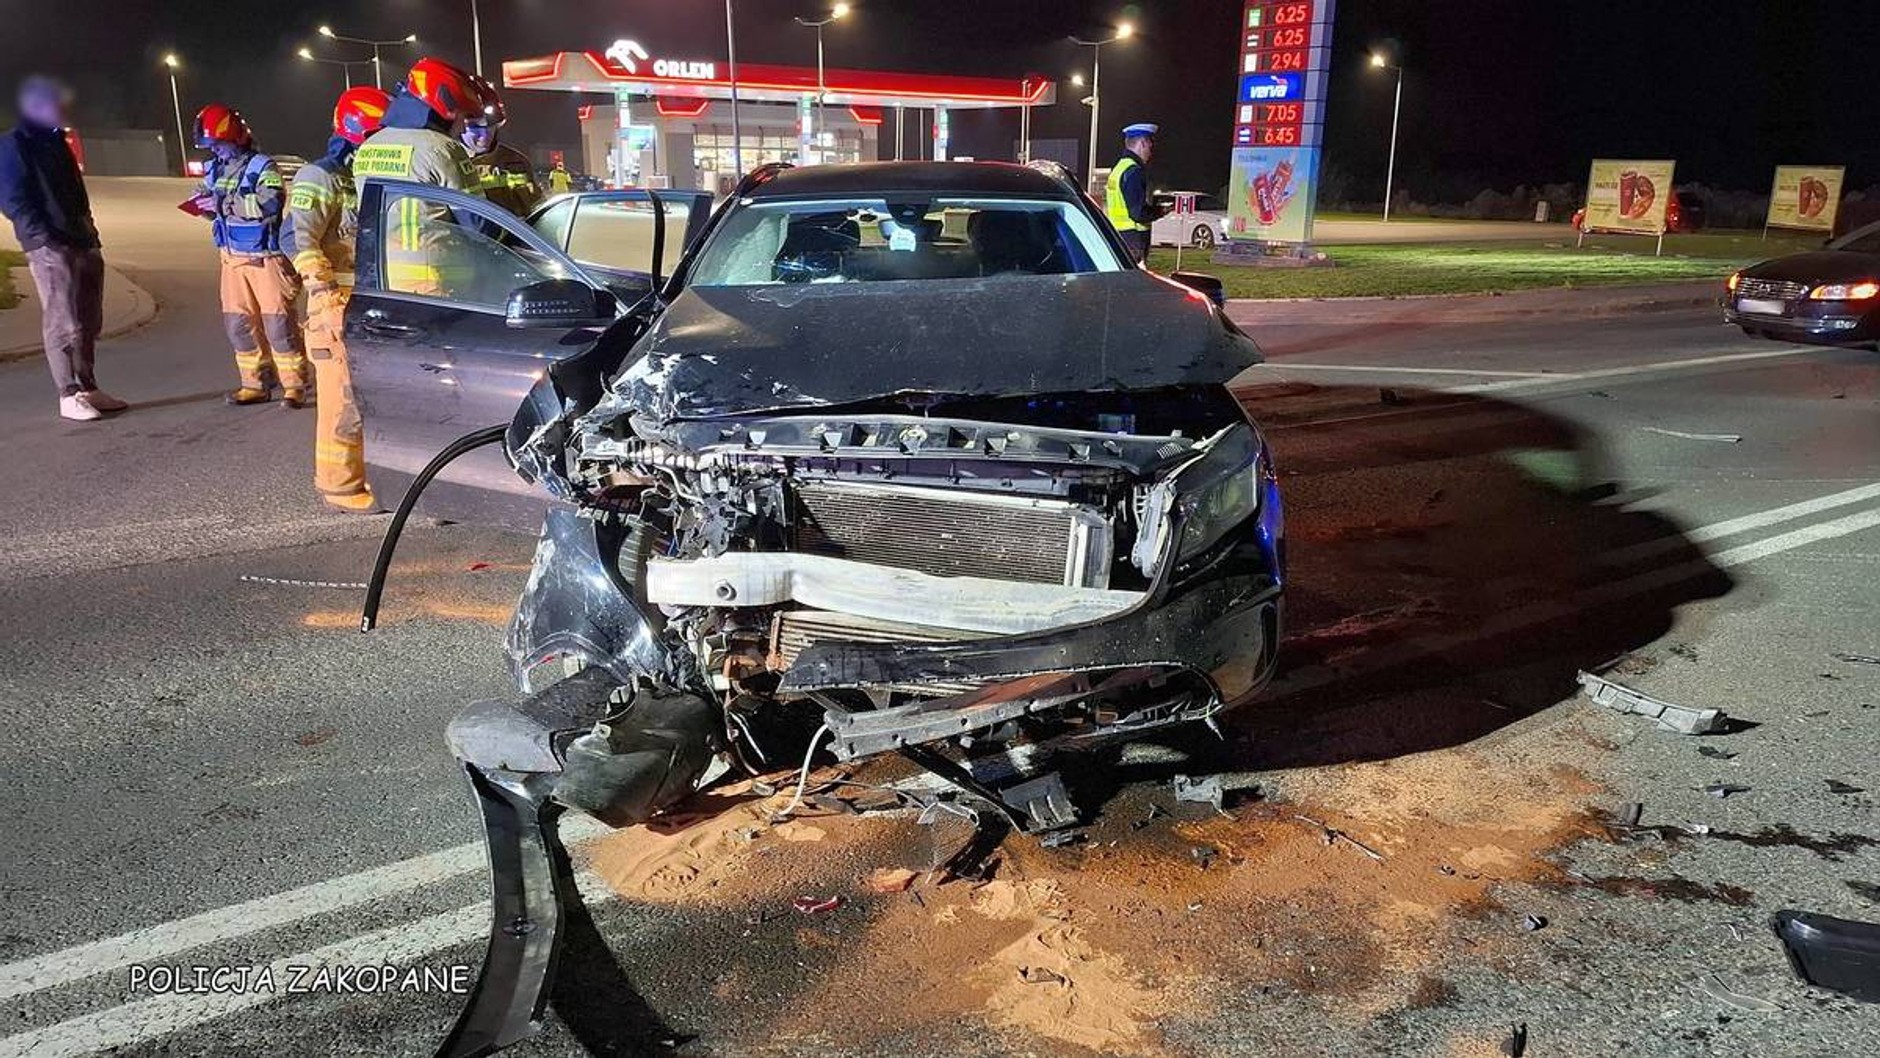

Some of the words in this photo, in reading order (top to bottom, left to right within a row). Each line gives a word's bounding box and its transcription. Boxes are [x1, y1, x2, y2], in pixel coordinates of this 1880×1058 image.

[1275, 5, 1307, 23] 6.25
[1273, 28, 1304, 47] 6.25
[653, 59, 714, 79] ORLEN
[1271, 52, 1302, 71] 2.94
[1249, 84, 1288, 99] verva
[1266, 104, 1297, 122] 7.05
[1264, 126, 1295, 145] 6.45
